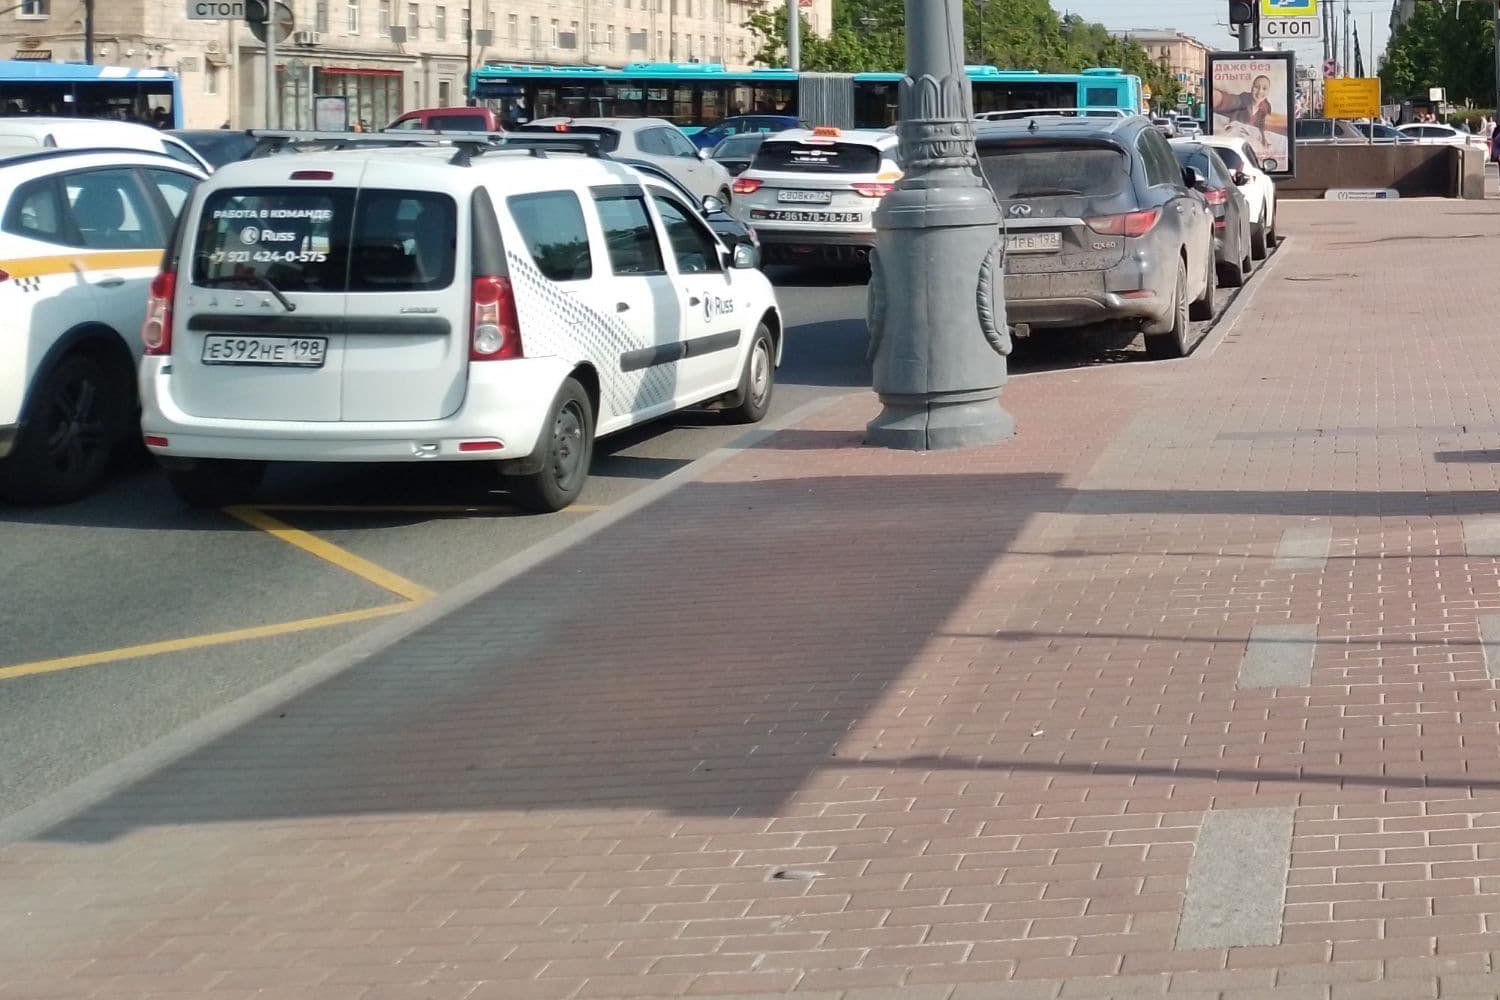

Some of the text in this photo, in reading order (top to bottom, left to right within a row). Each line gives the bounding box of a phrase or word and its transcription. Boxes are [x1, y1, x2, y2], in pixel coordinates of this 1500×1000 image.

[195, 2, 243, 16] СТОП
[1267, 21, 1311, 35] СТОП
[1215, 61, 1271, 72] даже без
[1215, 73, 1252, 81] опыта
[213, 209, 333, 219] РАБОТА В КОМАНДЕ
[261, 229, 297, 242] Russ
[253, 250, 327, 263] 424-0-575
[715, 296, 734, 315] Russ
